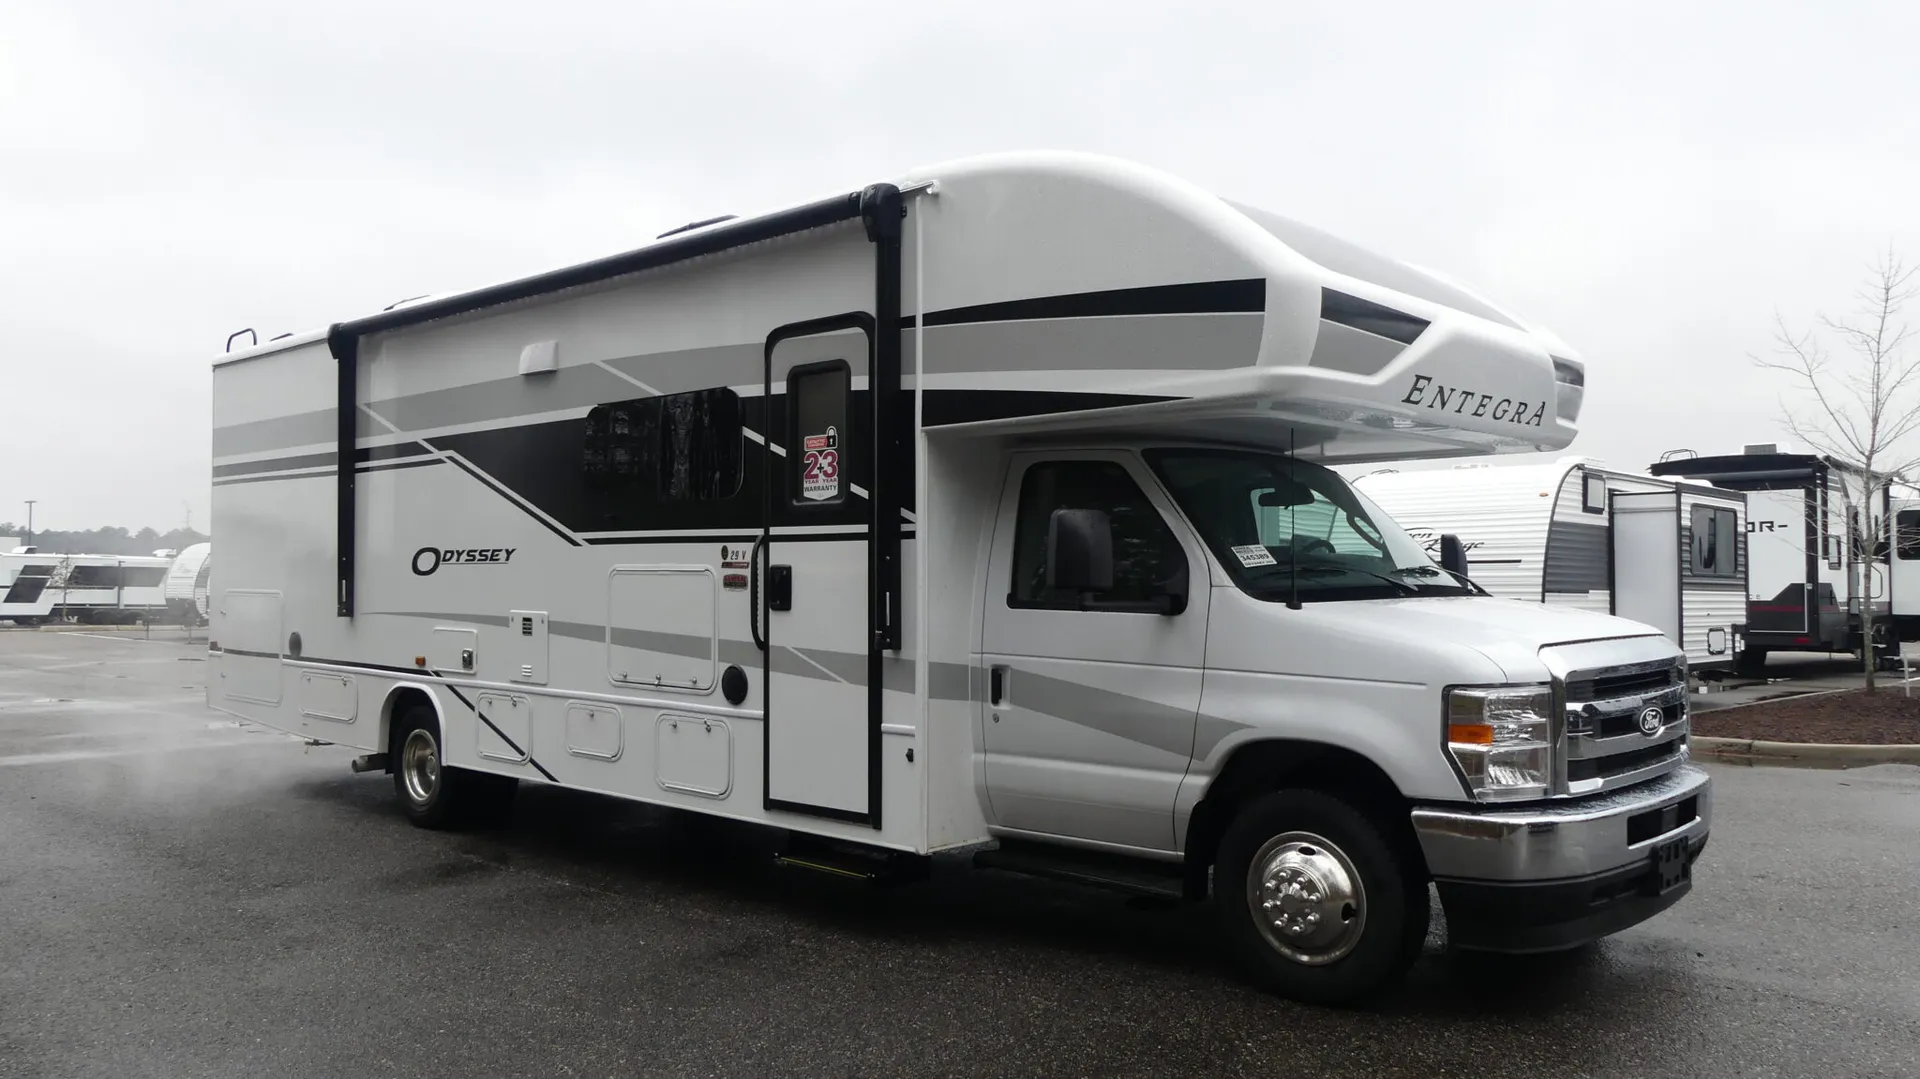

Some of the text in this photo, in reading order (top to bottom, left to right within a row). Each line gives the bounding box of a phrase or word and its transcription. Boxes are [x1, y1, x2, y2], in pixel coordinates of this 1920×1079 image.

[1401, 374, 1546, 426] ENTEGRA
[411, 547, 517, 577] ODYSSEY
[742, 550, 747, 560] V
[1644, 711, 1660, 729] Ford
